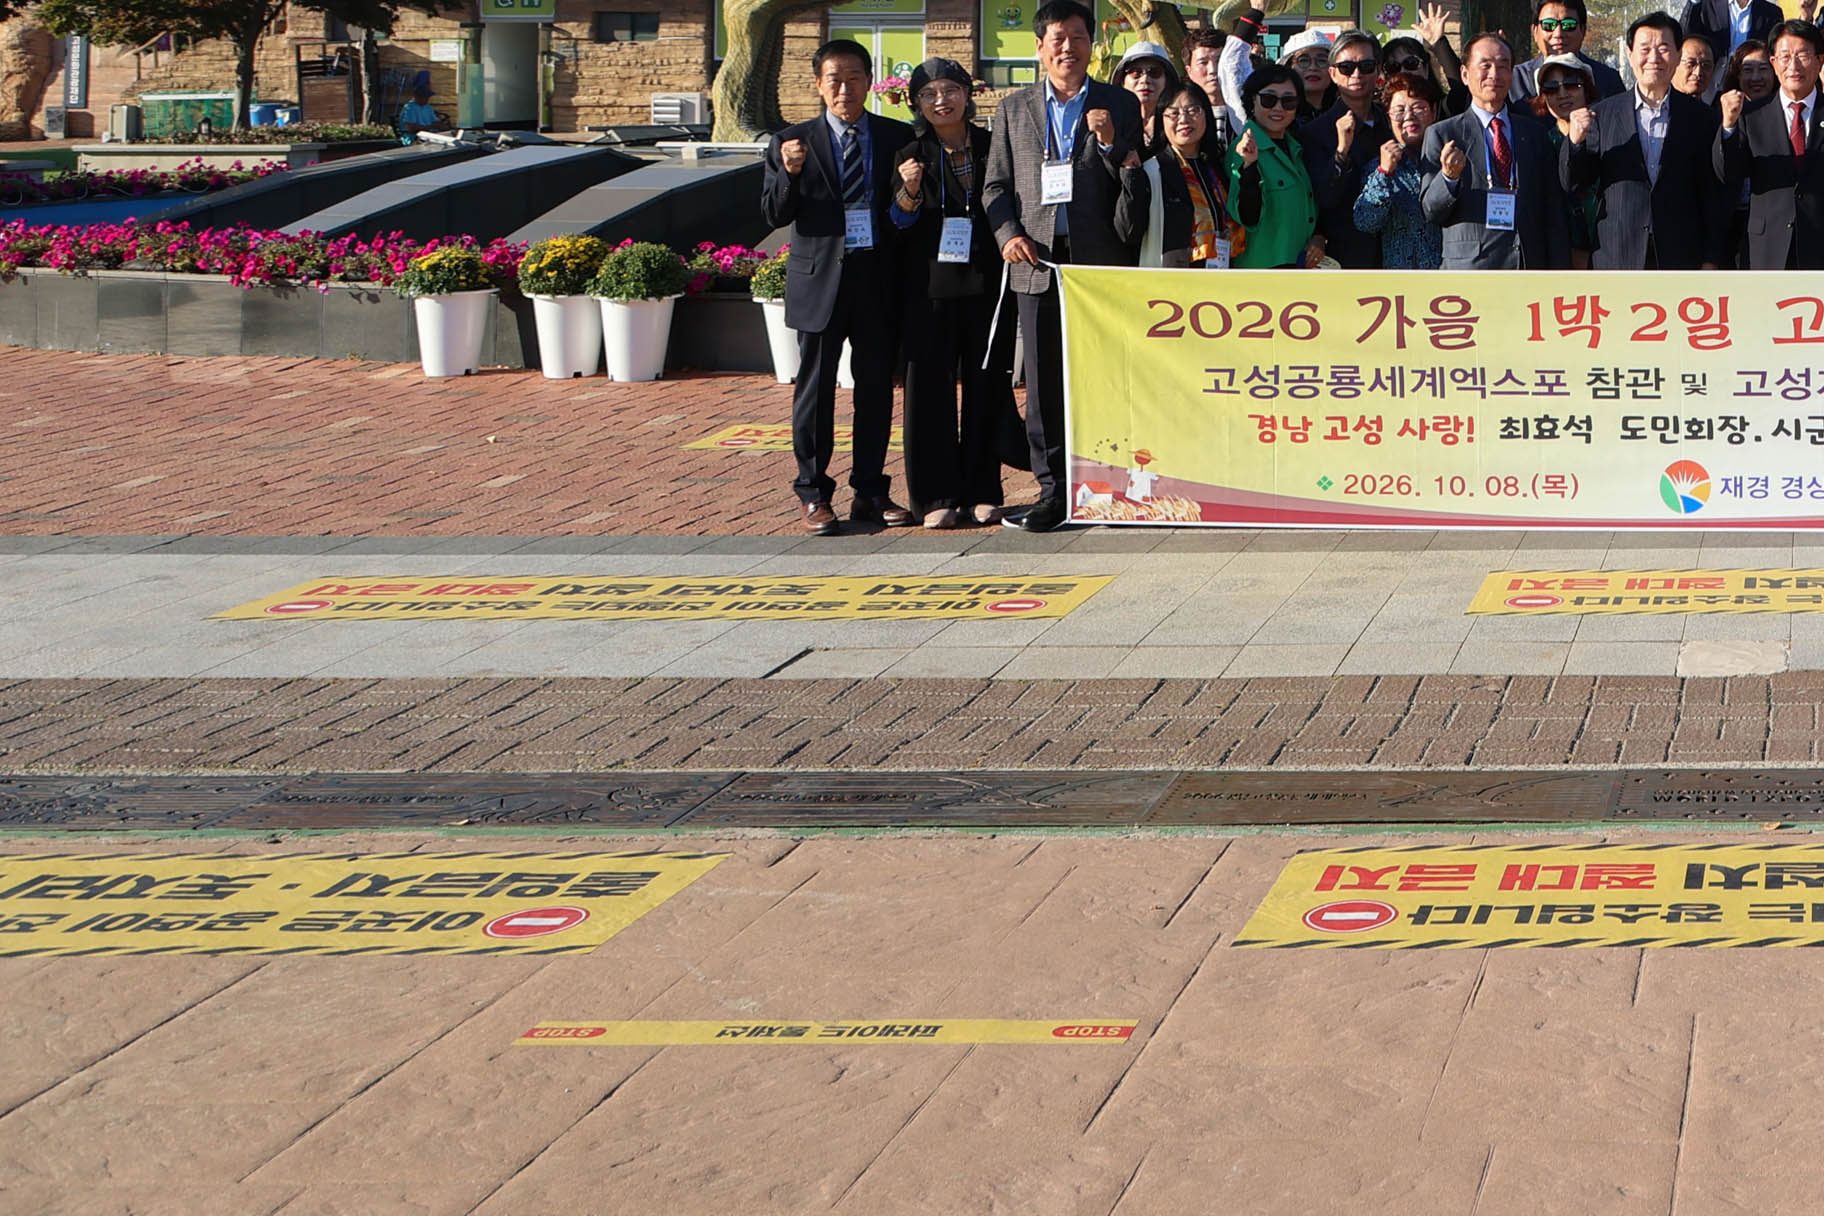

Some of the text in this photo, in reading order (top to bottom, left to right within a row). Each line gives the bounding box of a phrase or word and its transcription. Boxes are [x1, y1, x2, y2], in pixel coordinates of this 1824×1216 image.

[1146, 299, 1321, 341] 2026
[1355, 294, 1481, 351] 가을
[1202, 364, 1571, 400] 고성공룡세계엑스포
[1585, 367, 1666, 400] 참관
[1681, 371, 1709, 396] 및
[1247, 414, 1313, 445] 경남
[1323, 414, 1384, 445] 고성
[1396, 414, 1475, 445] 사랑!
[1499, 413, 1593, 445] 최효석
[1343, 472, 1579, 500] 2026. 10. 08.(목)
[1719, 475, 1769, 500] 재경
[18, 871, 660, 900] 출입금지 돗자리
[1314, 864, 1478, 891] 금지
[1500, 862, 1658, 890] 절대
[64, 910, 280, 933] 공연이
[280, 910, 486, 933] 이곳은
[1406, 903, 1724, 926] 장소입니다
[532, 1028, 593, 1037] STOP
[817, 1025, 943, 1037] 퍼레이드
[1063, 1027, 1121, 1036] STOP
